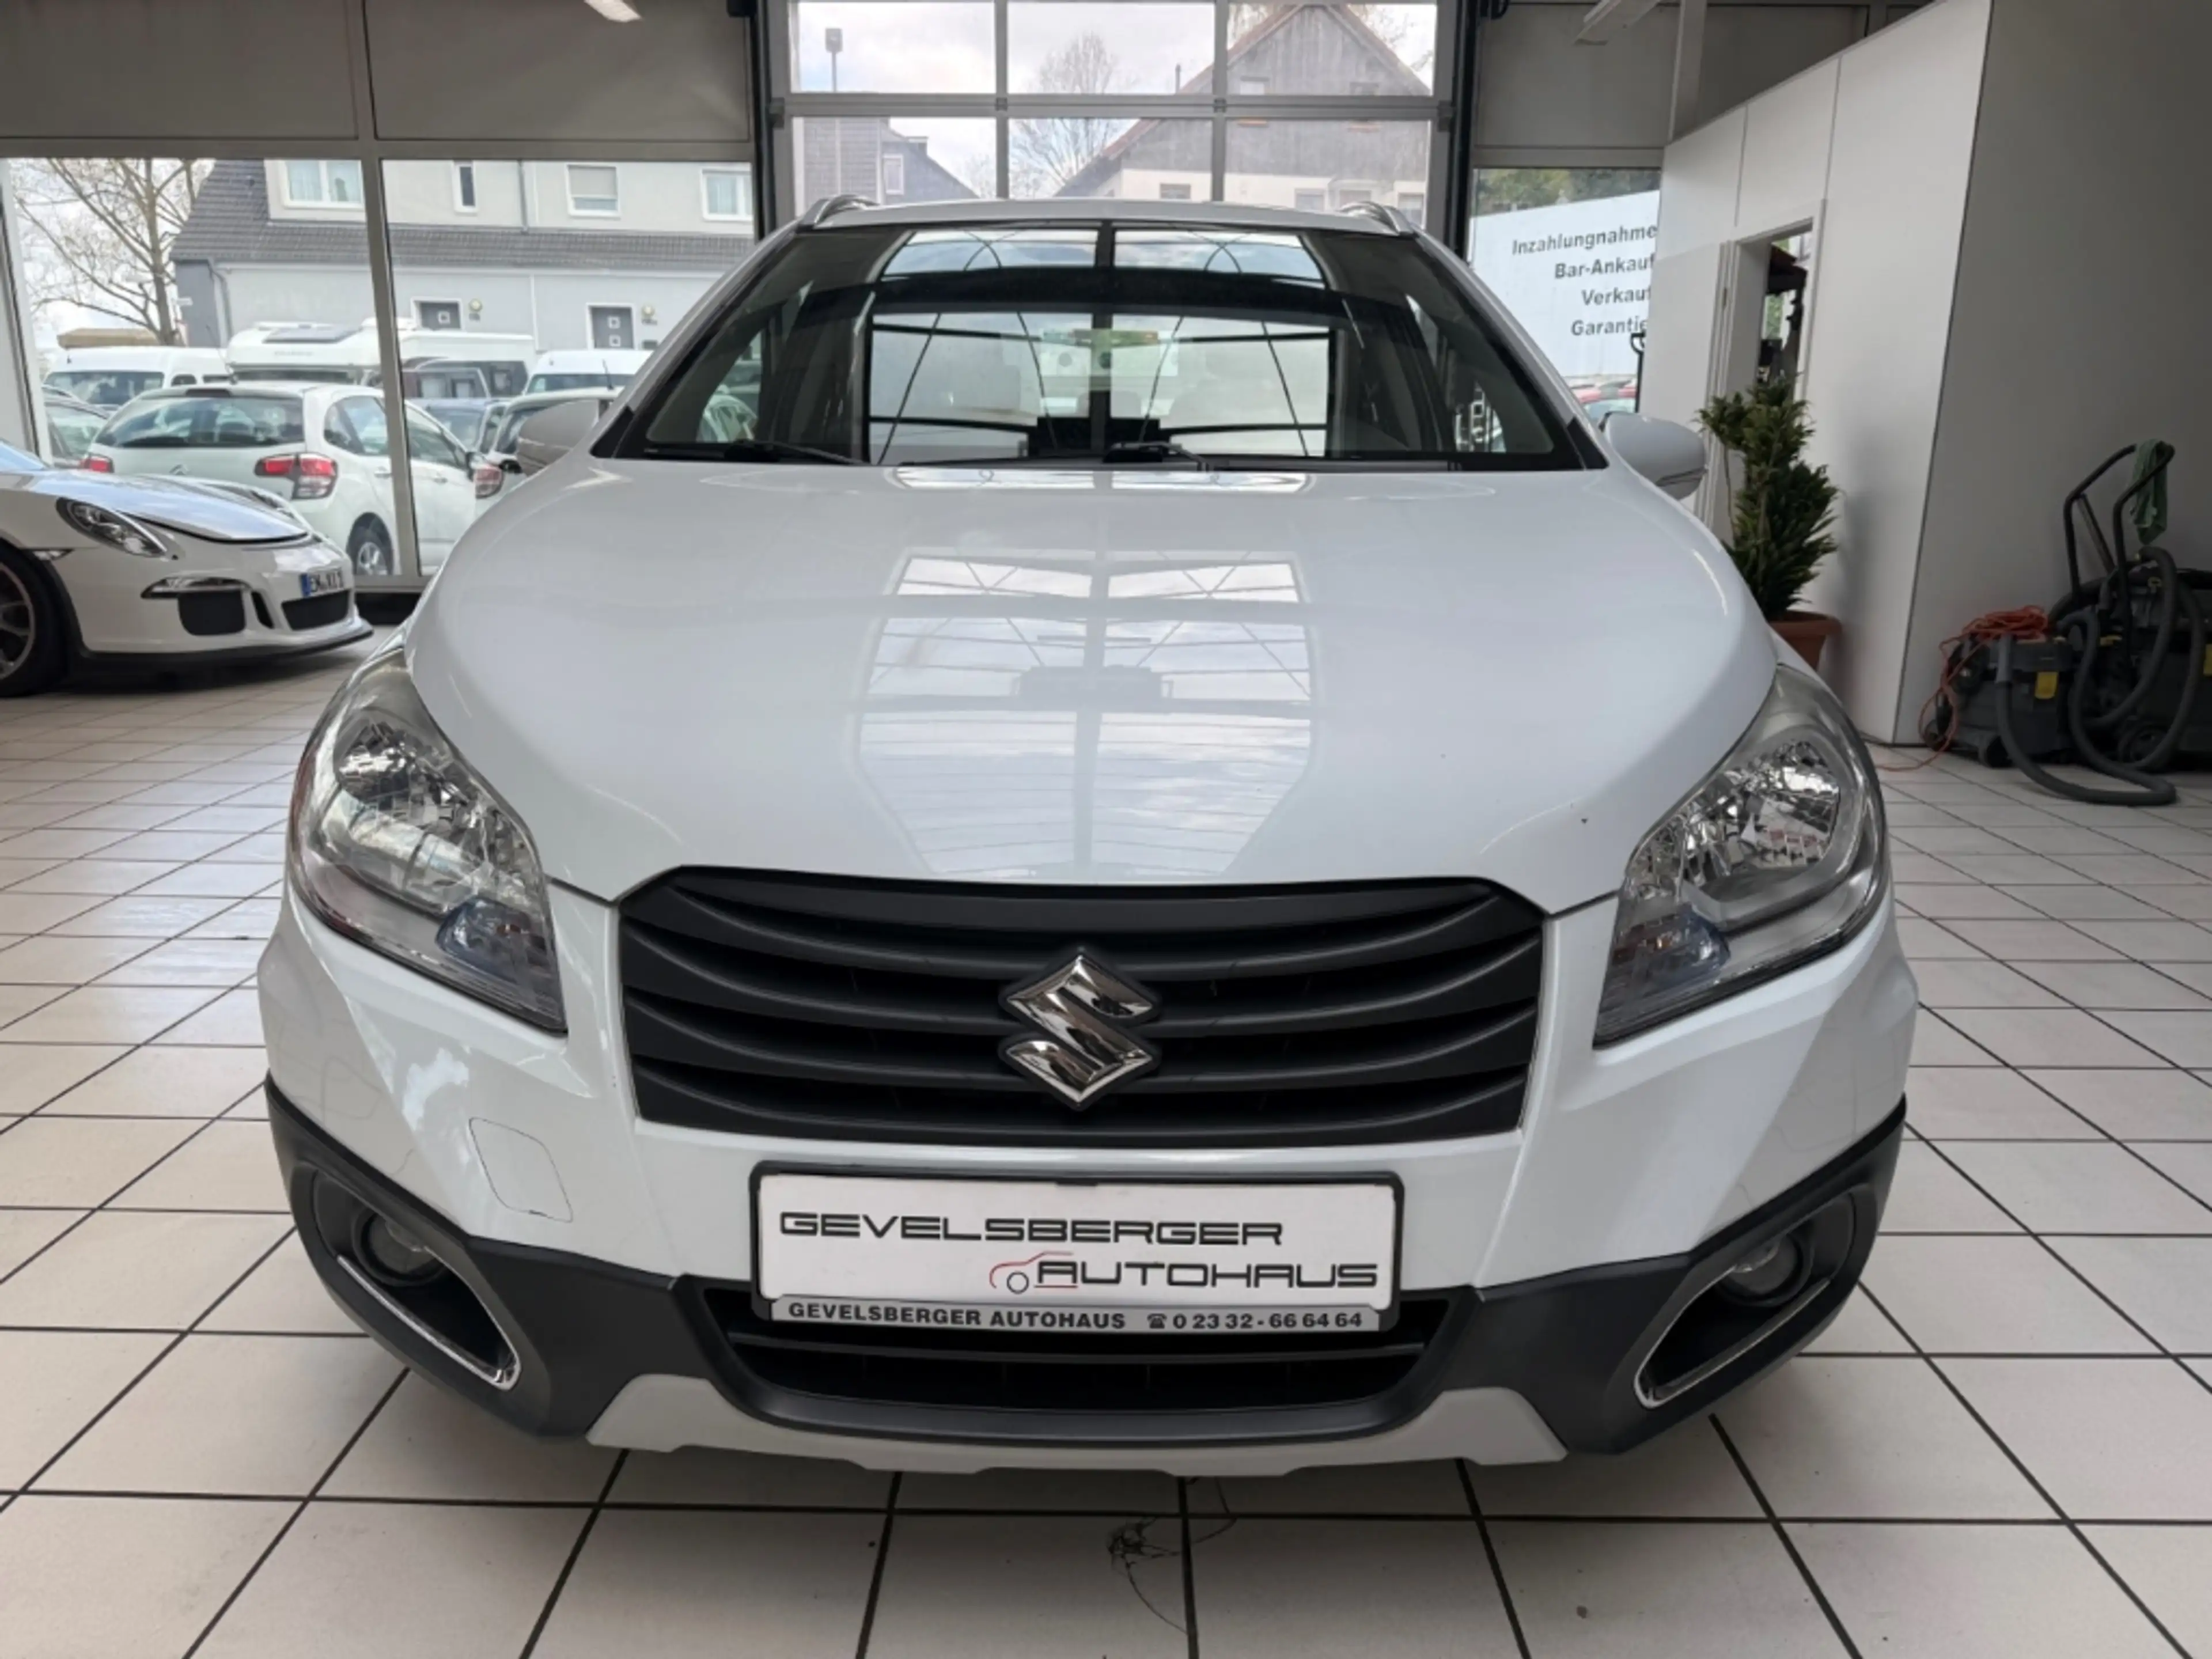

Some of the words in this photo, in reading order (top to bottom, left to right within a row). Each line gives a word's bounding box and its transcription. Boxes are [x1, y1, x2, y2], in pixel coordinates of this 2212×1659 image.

[1512, 225, 1657, 255] Inzahlungnahme
[779, 1211, 1283, 1246] GEVELSBERGER
[1037, 1260, 1378, 1289] AUTOHAUS
[788, 1302, 982, 1326] GEVELSBERGER
[990, 1310, 1126, 1330] AUTOHAUS
